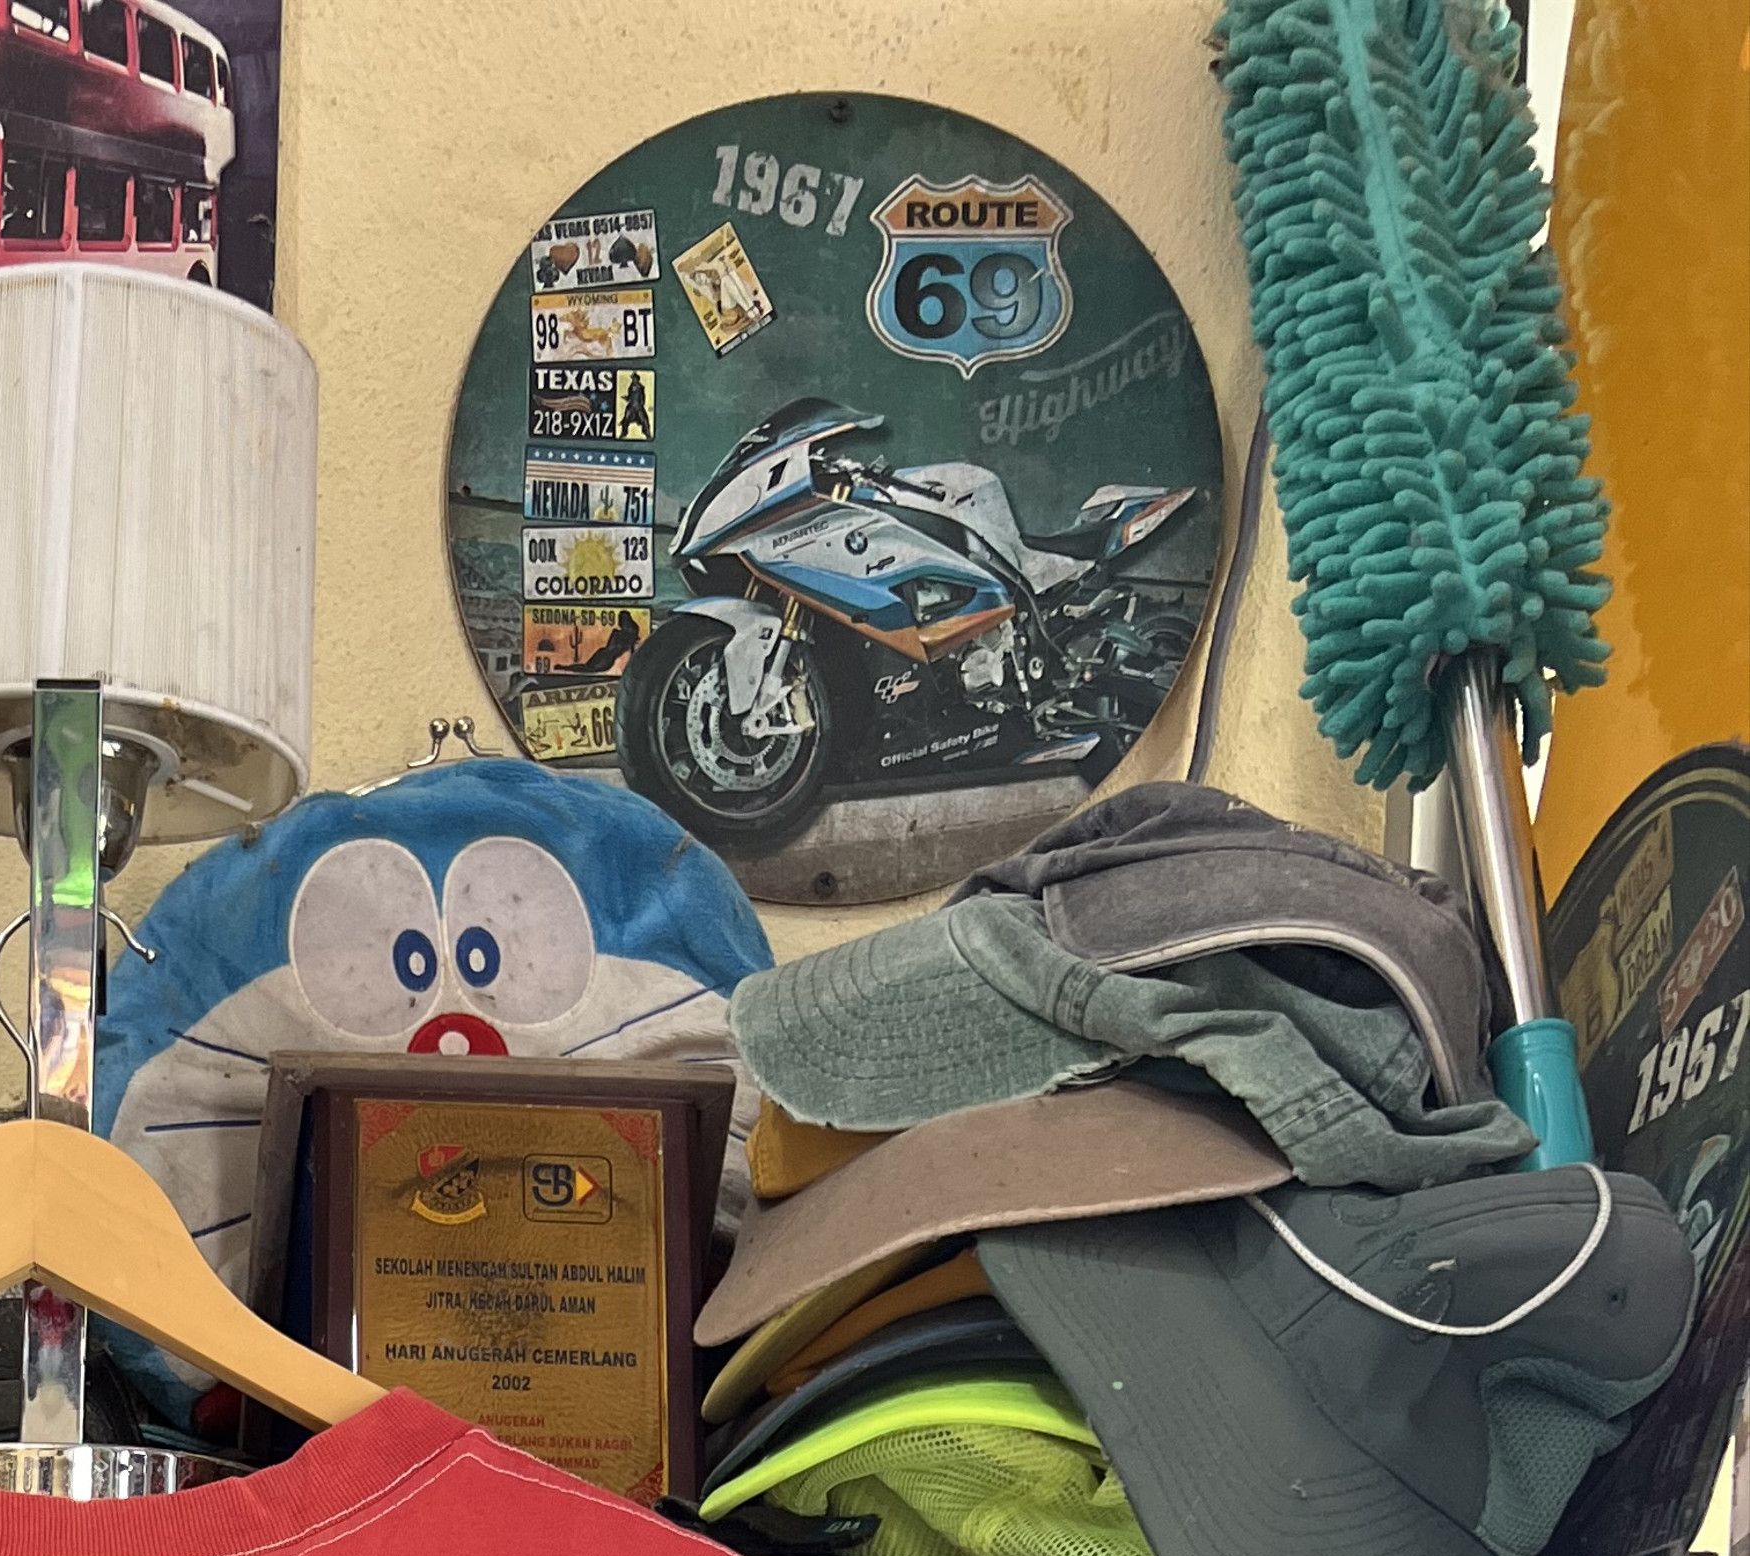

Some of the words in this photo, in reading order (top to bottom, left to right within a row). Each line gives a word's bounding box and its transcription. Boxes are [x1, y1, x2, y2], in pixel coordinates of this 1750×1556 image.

[712, 144, 864, 237] 1967
[905, 200, 1039, 229] ROUTE
[566, 293, 619, 306] WYOMING
[895, 252, 1043, 340] 69
[536, 313, 559, 350] 98
[623, 308, 652, 347] BT
[535, 368, 613, 391] TEXAS
[979, 316, 1189, 446] Highway
[531, 480, 590, 520] NEVADA
[623, 486, 649, 524] 751
[623, 536, 648, 561] 123
[535, 574, 643, 596] COLORADO
[880, 745, 928, 768] Official
[930, 734, 971, 754] Safety
[1627, 988, 1750, 1136] 1967
[375, 1256, 433, 1277] SEKOLAH
[436, 1259, 507, 1280] MENENGAH
[509, 1262, 558, 1282] SULTAN
[561, 1263, 604, 1283] ABDUL
[607, 1265, 646, 1285] HALIM
[515, 1295, 556, 1313] DARUL
[559, 1296, 596, 1315] AMAN
[385, 1343, 426, 1362] HARI
[431, 1345, 527, 1364] ANUGERAH
[532, 1348, 638, 1368] CEMERLANG
[491, 1374, 532, 1391] 2002
[478, 1413, 545, 1428] ANUGERAH
